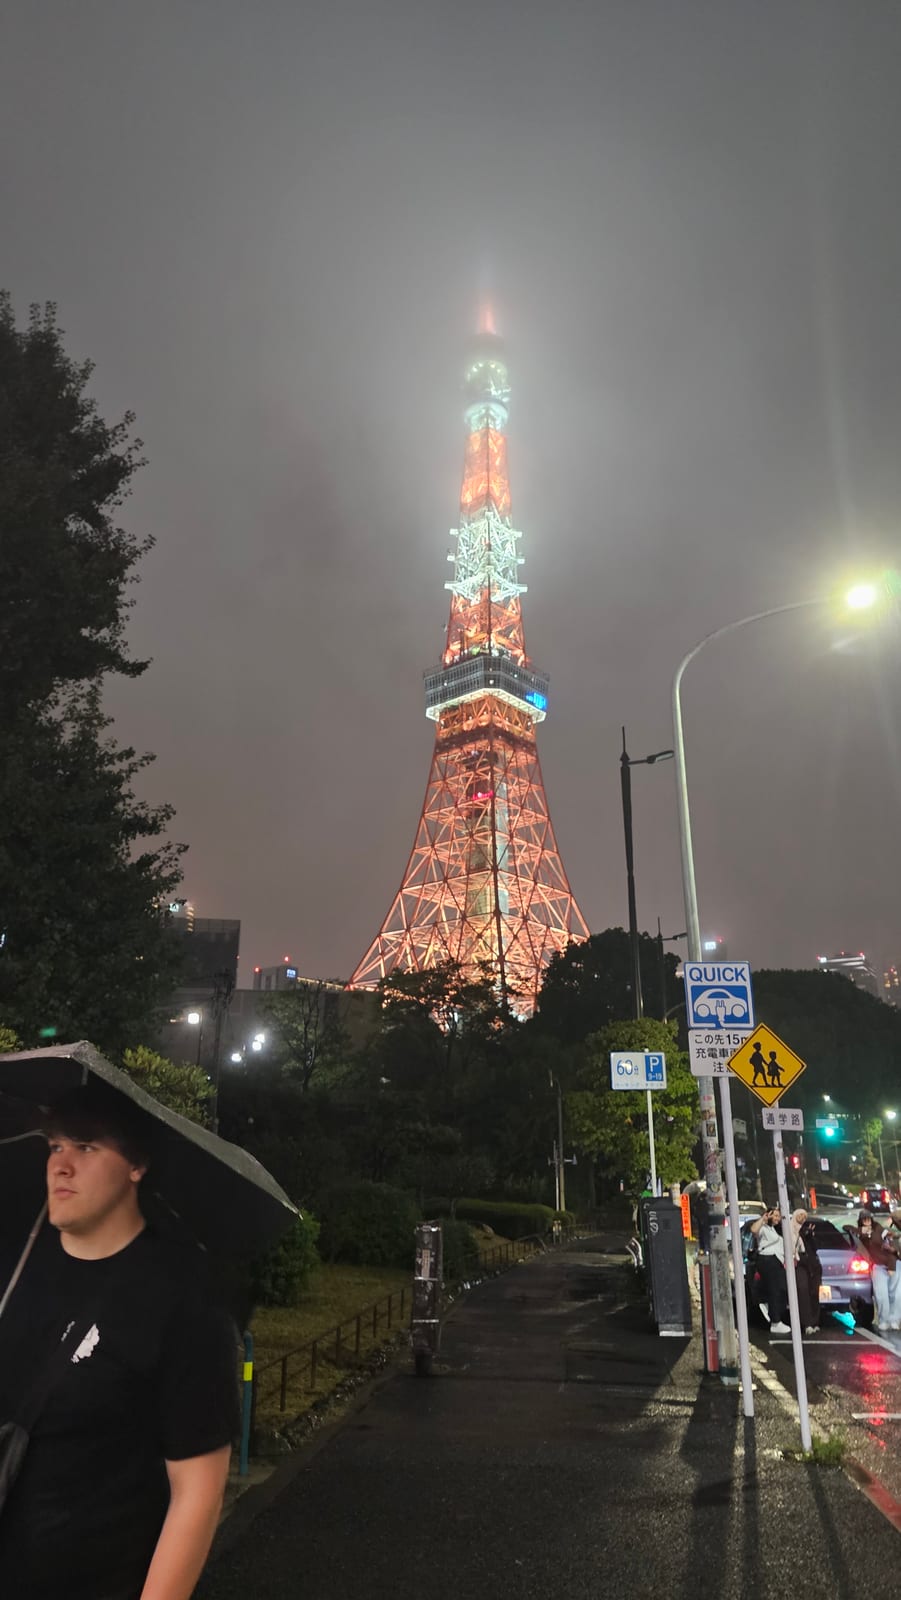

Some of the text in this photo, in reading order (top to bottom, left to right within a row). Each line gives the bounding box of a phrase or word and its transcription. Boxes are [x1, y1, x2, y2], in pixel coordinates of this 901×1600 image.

[689, 967, 747, 982] QUICK
[649, 1056, 660, 1073] P
[713, 1061, 733, 1073] 注
